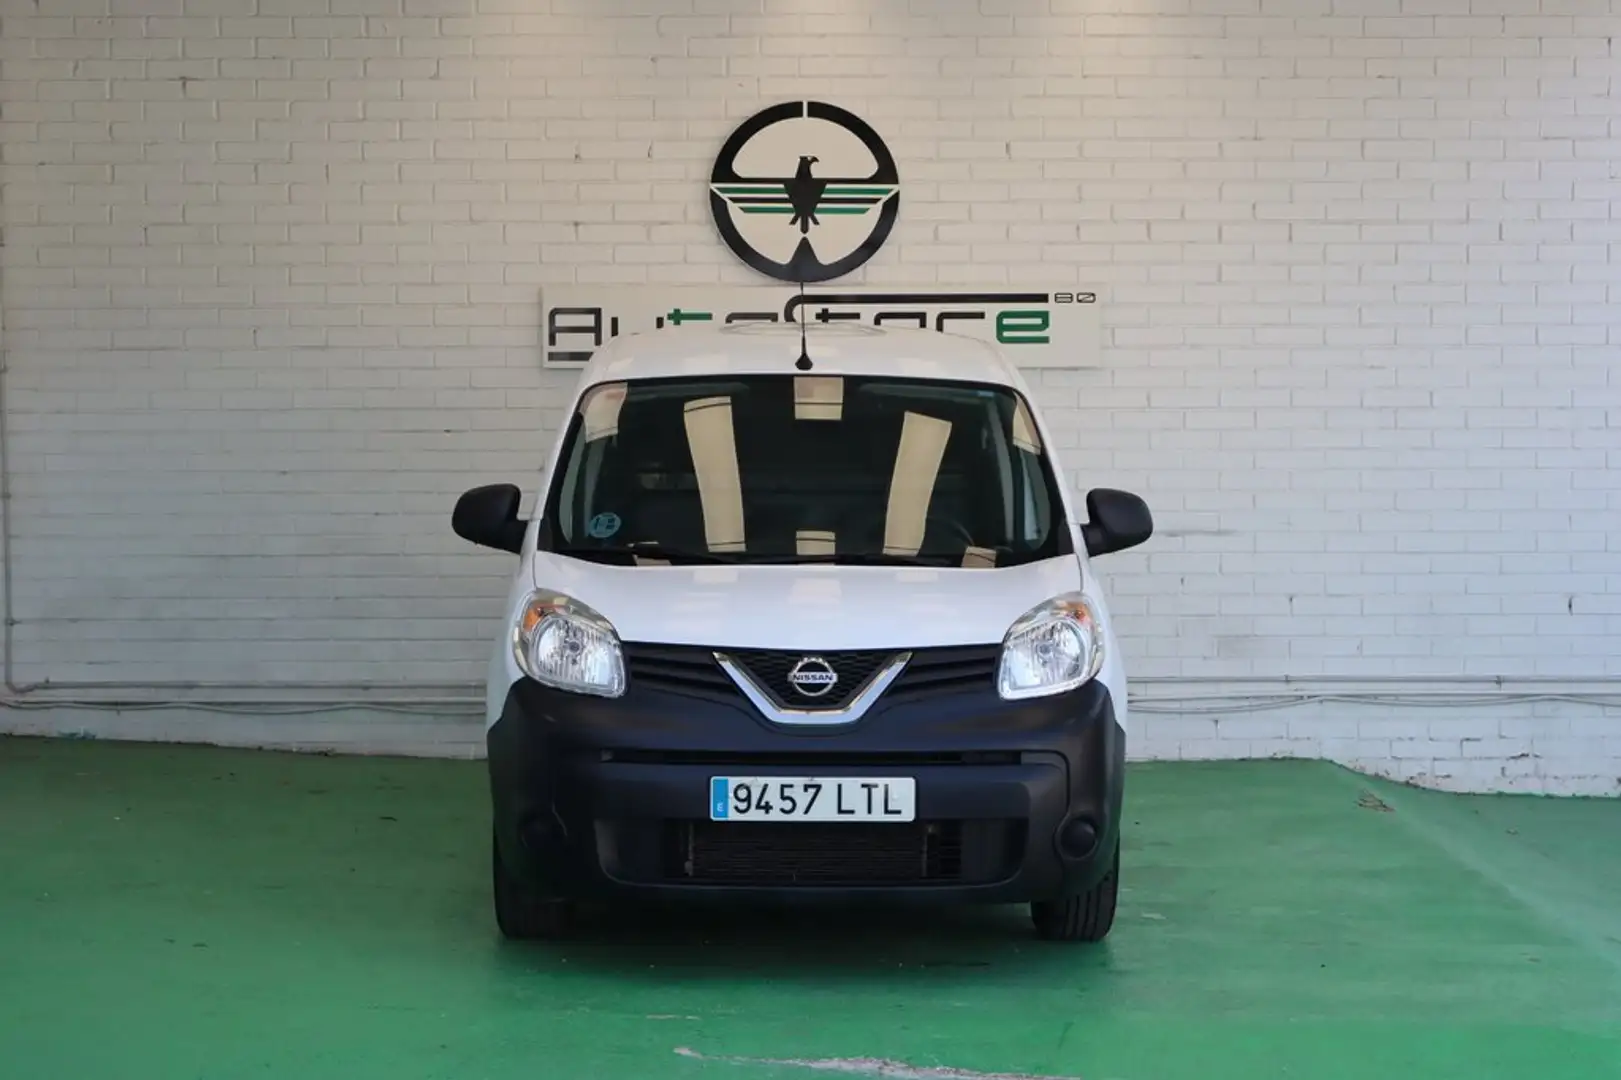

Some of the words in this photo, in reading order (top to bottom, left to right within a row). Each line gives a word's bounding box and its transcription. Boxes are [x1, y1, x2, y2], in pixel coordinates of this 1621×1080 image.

[792, 673, 834, 681] NISSAN
[717, 802, 724, 812] E
[732, 783, 823, 815] 9457
[837, 783, 902, 815] LTL
